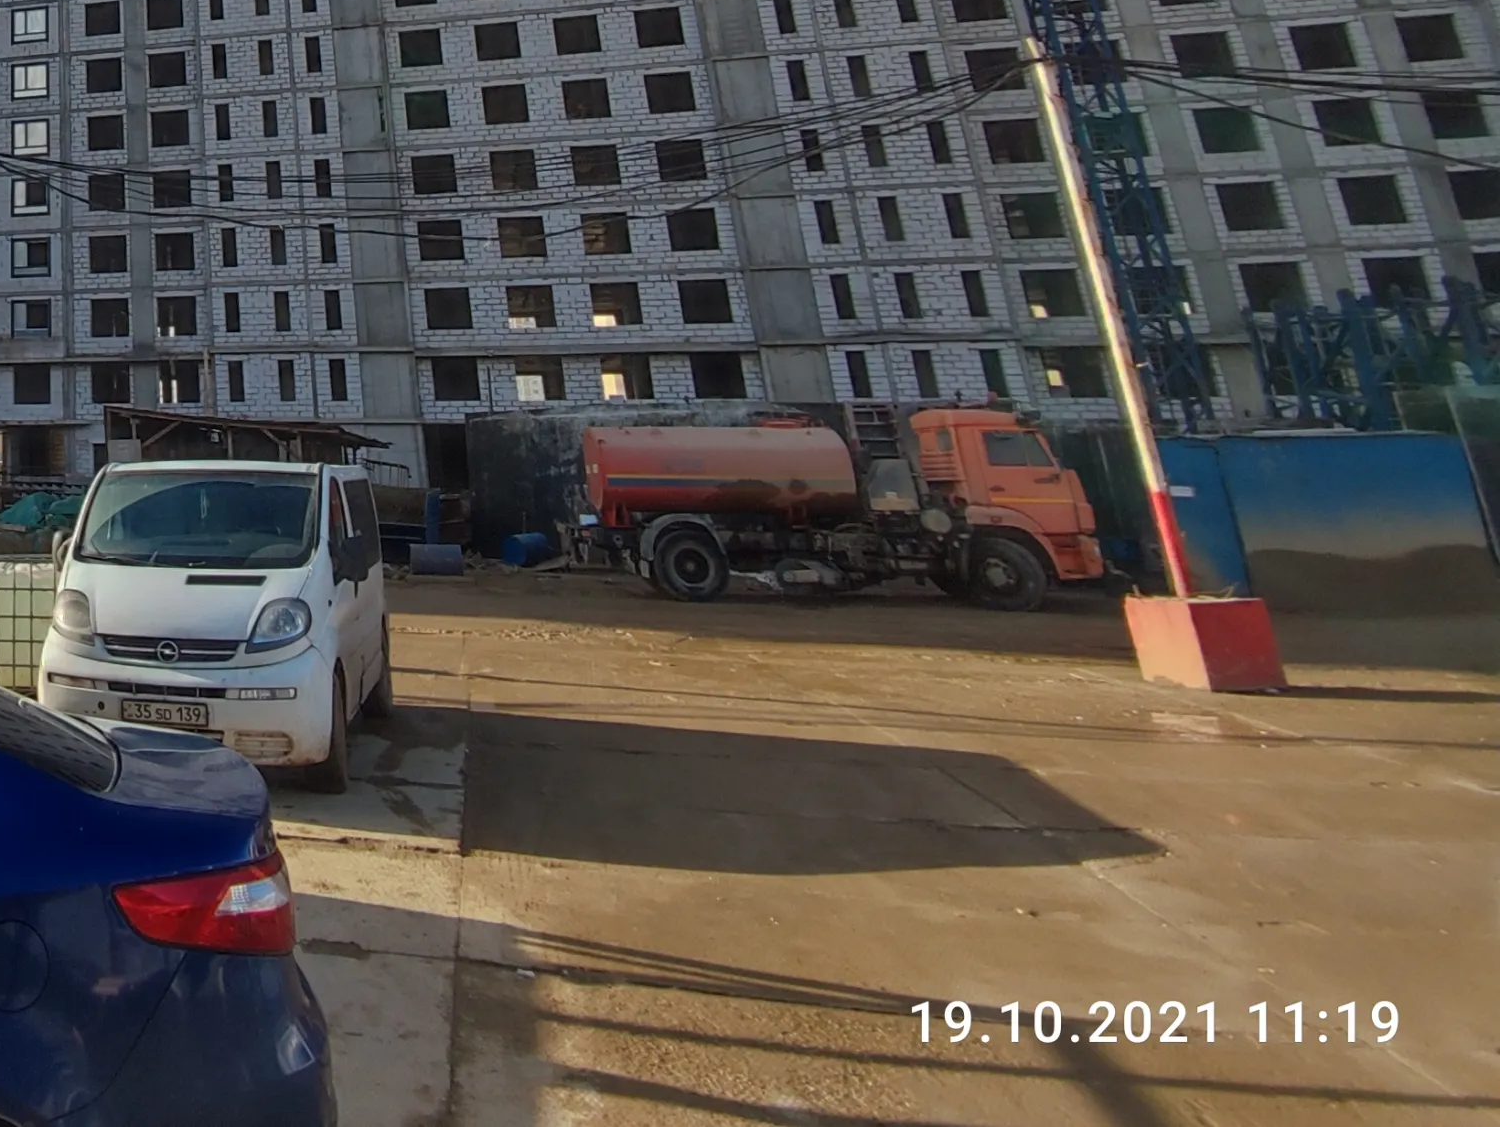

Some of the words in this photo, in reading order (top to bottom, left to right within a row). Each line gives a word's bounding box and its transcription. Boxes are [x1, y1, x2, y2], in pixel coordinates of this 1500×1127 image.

[134, 704, 152, 719] 35
[155, 708, 172, 721] SD
[176, 706, 201, 723] 139
